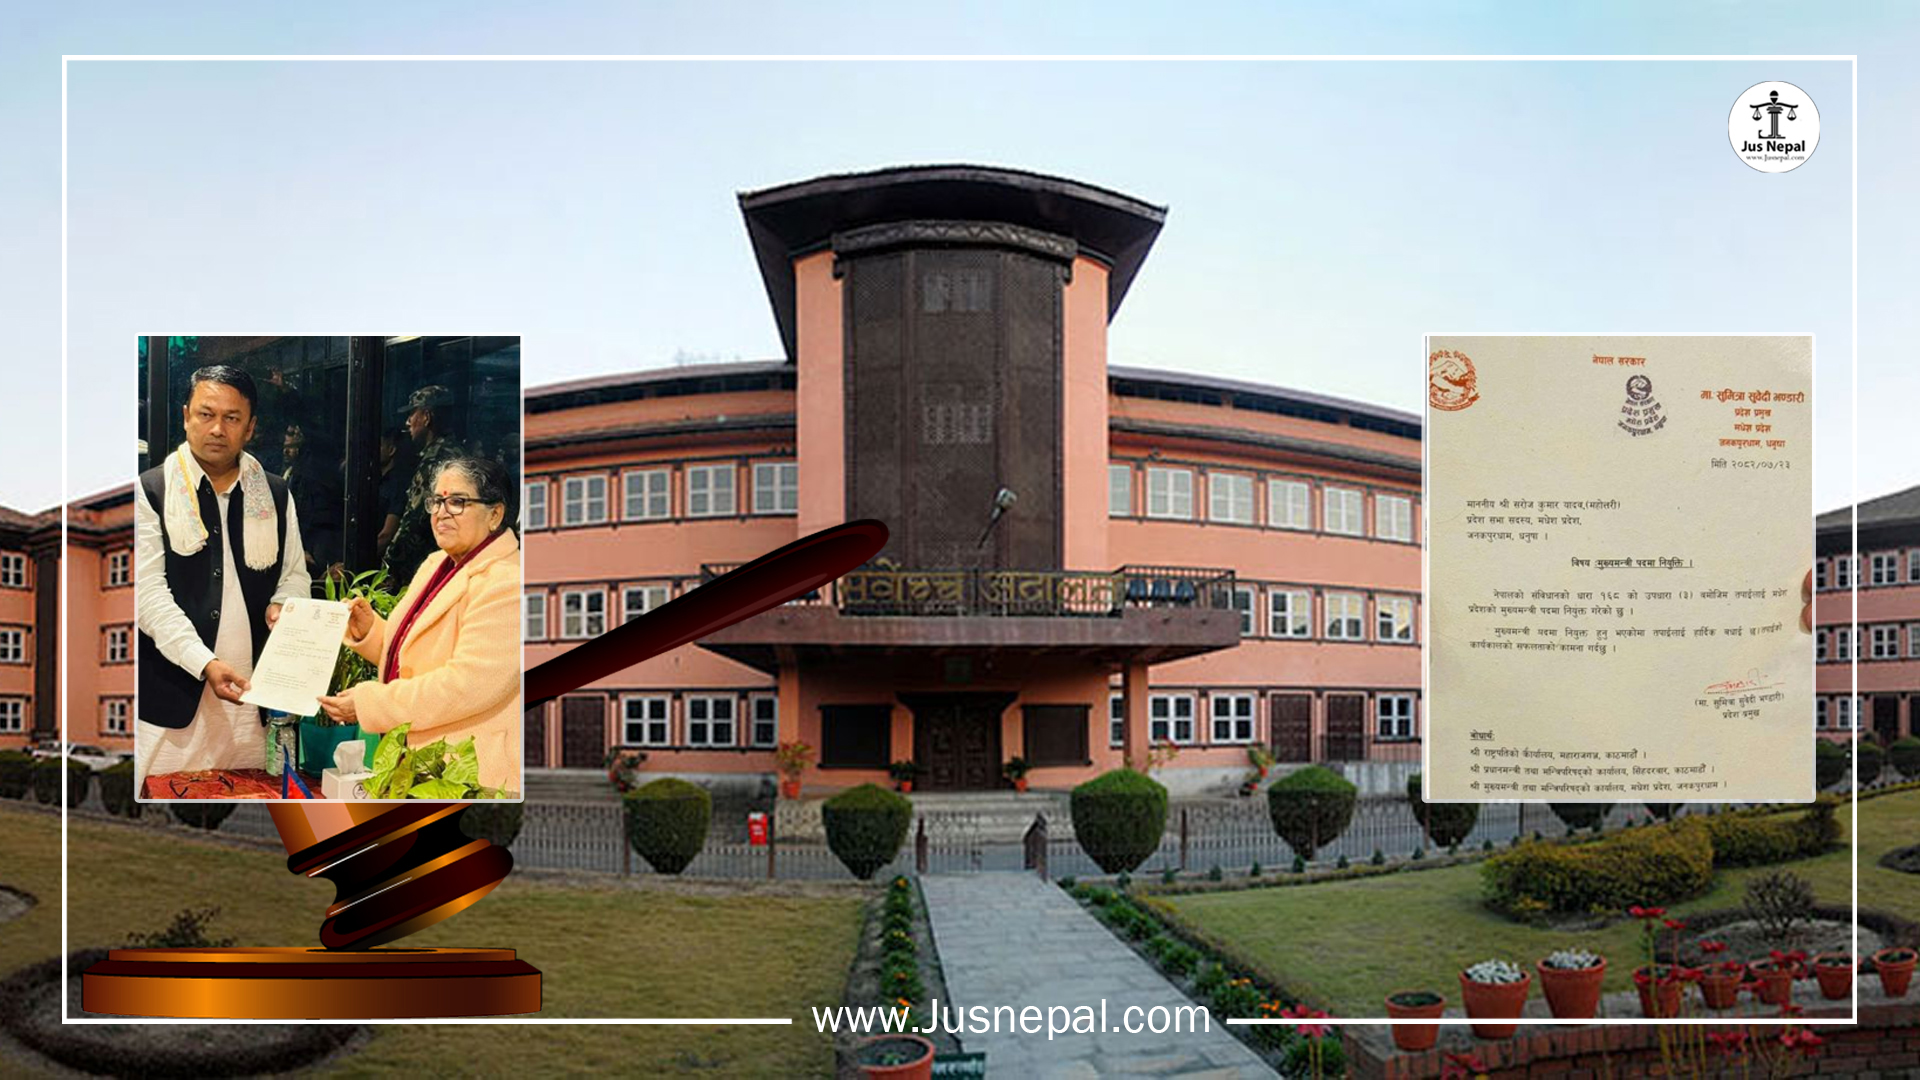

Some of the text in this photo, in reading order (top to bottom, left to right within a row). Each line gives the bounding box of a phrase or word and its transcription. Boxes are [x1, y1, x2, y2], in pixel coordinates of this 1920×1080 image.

[1592, 355, 1646, 367] नेपाल सरकार
[1717, 389, 1745, 403] सुमित्रा
[1748, 390, 1771, 403] सुवेदी
[1773, 392, 1804, 403] भण्डारी
[1734, 407, 1750, 416] प्रदेश
[1756, 423, 1771, 432] प्रदेश
[1711, 458, 1790, 469] मिति २०८२/०७/२३
[1466, 499, 1495, 508] माननीय
[1499, 499, 1509, 508] श्री
[1514, 498, 1534, 508] सरोज
[1538, 501, 1559, 512] कुमार
[1466, 514, 1484, 524] प्रदेश
[1489, 516, 1504, 524] सभा
[1538, 515, 1557, 524] मधेश
[1519, 532, 1538, 543] धनुषा
[1571, 557, 1590, 567] विषय
[1636, 559, 1655, 567] पदमा
[1659, 557, 1684, 569] नियुक्ति
[1494, 589, 1524, 600] नेपालको
[1531, 589, 1569, 600] संविधानको
[1577, 592, 1592, 600] धारा
[1600, 592, 1619, 600] १६८
[1627, 589, 1638, 599] को
[1645, 592, 1671, 600] उपधारा
[1468, 604, 1496, 613] प्रदेशको
[1501, 605, 1537, 616] मुख्यमन्त्री
[1563, 605, 1586, 618] नियुक्त
[1591, 604, 1612, 615] गरेको
[1616, 608, 1624, 618] छु
[1494, 627, 1530, 637] मुख्यमन्त्री
[1565, 627, 1588, 640] नियुक्त
[1596, 629, 1607, 640] हुनु
[1616, 627, 1645, 636] भएकोमा
[1694, 627, 1716, 637] हार्दिक
[1470, 640, 1512, 649] कार्यकालको
[1517, 641, 1554, 651] सफलताको
[1560, 644, 1583, 652] कामना
[1723, 709, 1760, 720] प्रदेश प्रमुख
[1471, 747, 1479, 756] श्री
[1484, 747, 1518, 758] राष्ट्रपतिको
[1471, 764, 1479, 773] श्री
[1484, 765, 1520, 774] प्रधानमन्त्री
[1471, 781, 1479, 790] श्री
[1484, 782, 1518, 793] मुख्यमन्त्री
[1631, 783, 1649, 791] मधेश
[1677, 782, 1718, 792] जनकपुरधाम
